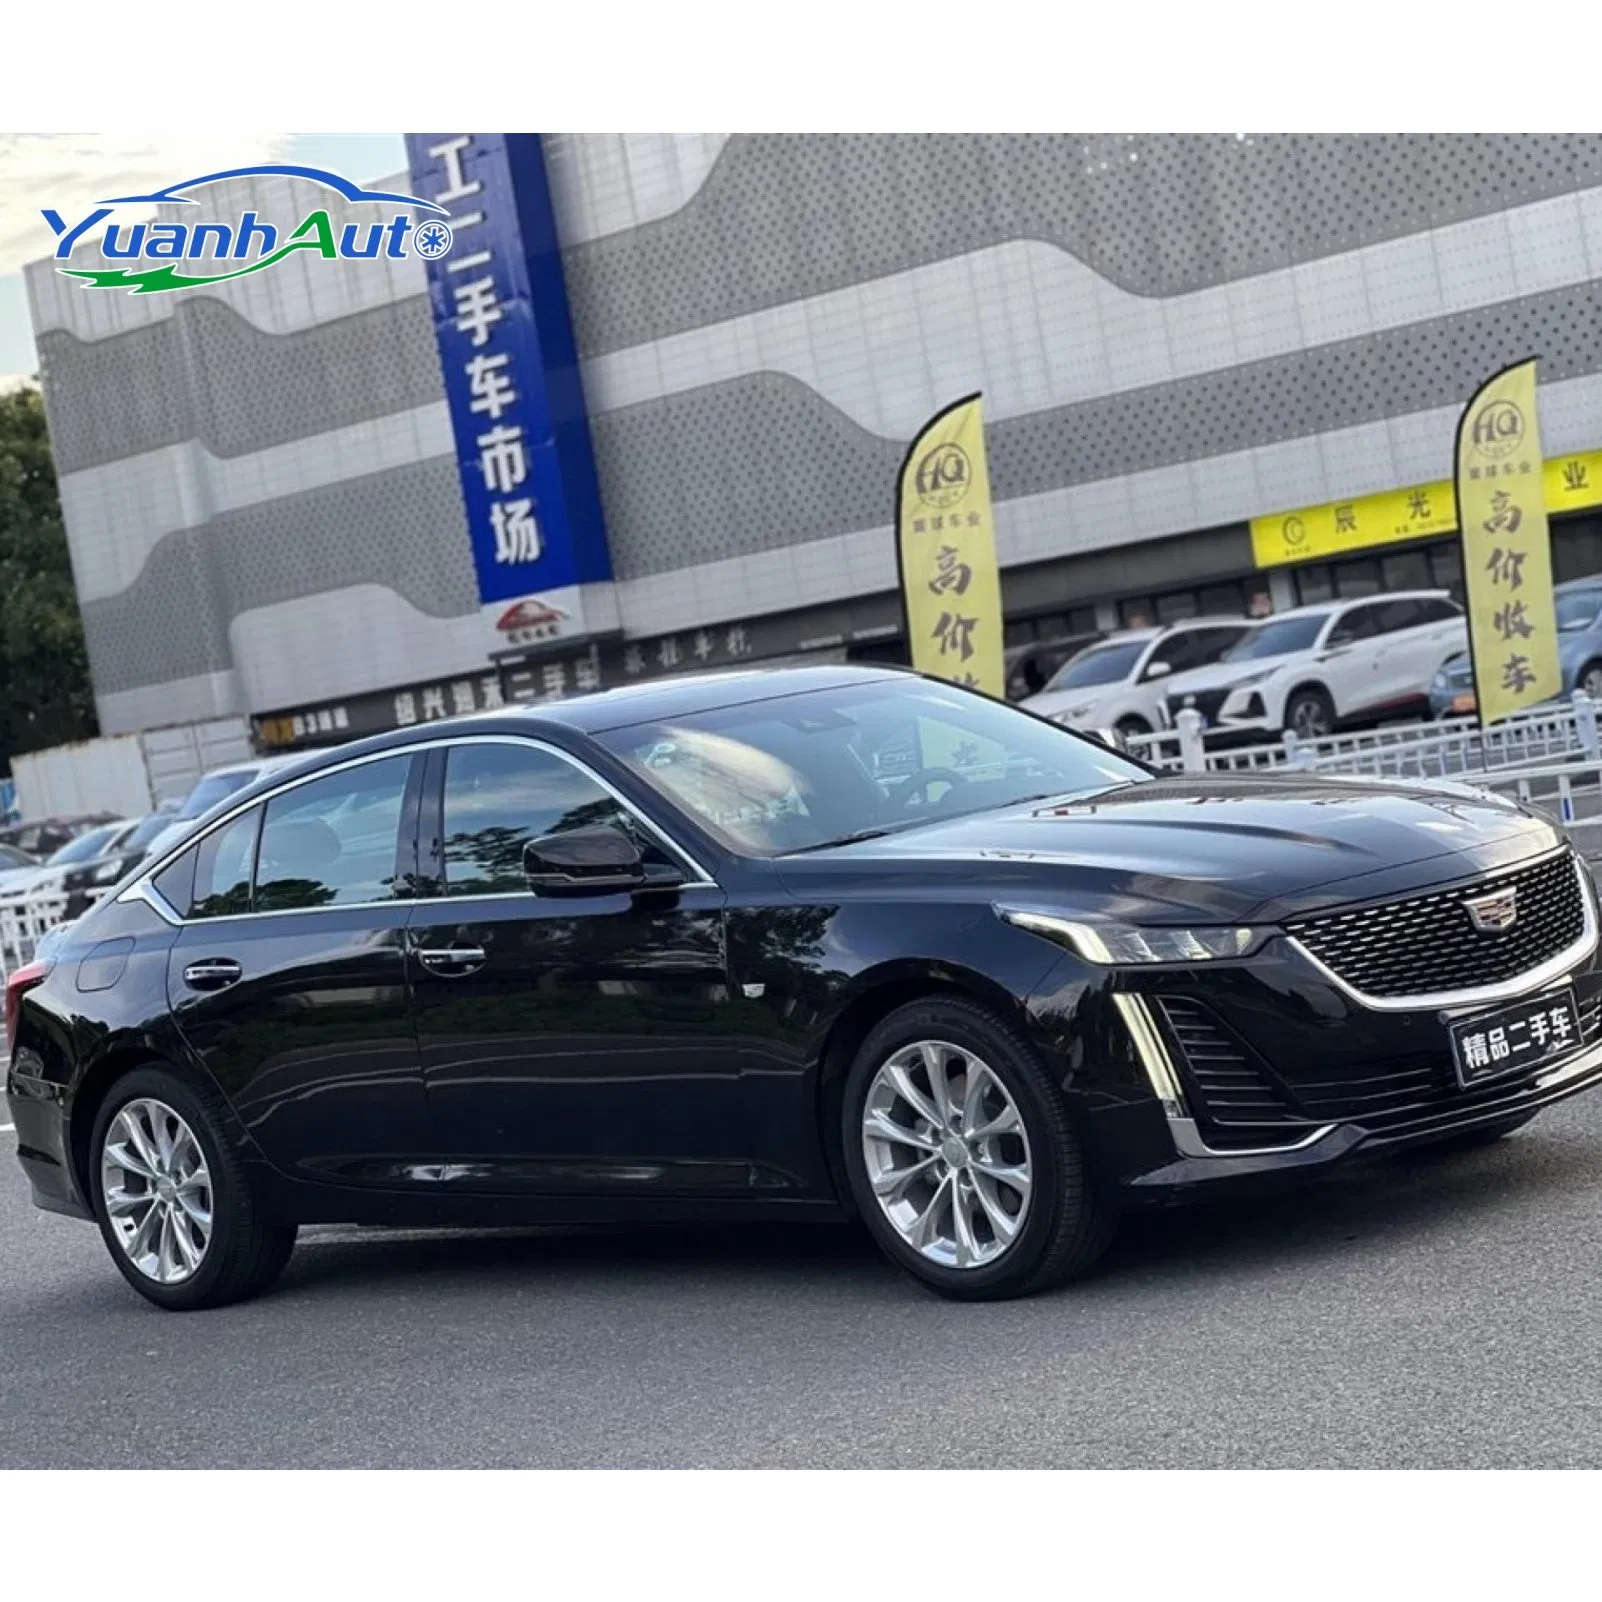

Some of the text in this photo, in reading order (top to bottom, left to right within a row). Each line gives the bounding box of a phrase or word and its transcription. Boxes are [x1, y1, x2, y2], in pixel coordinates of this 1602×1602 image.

[1461, 1006, 1572, 1069] 精品二手车
